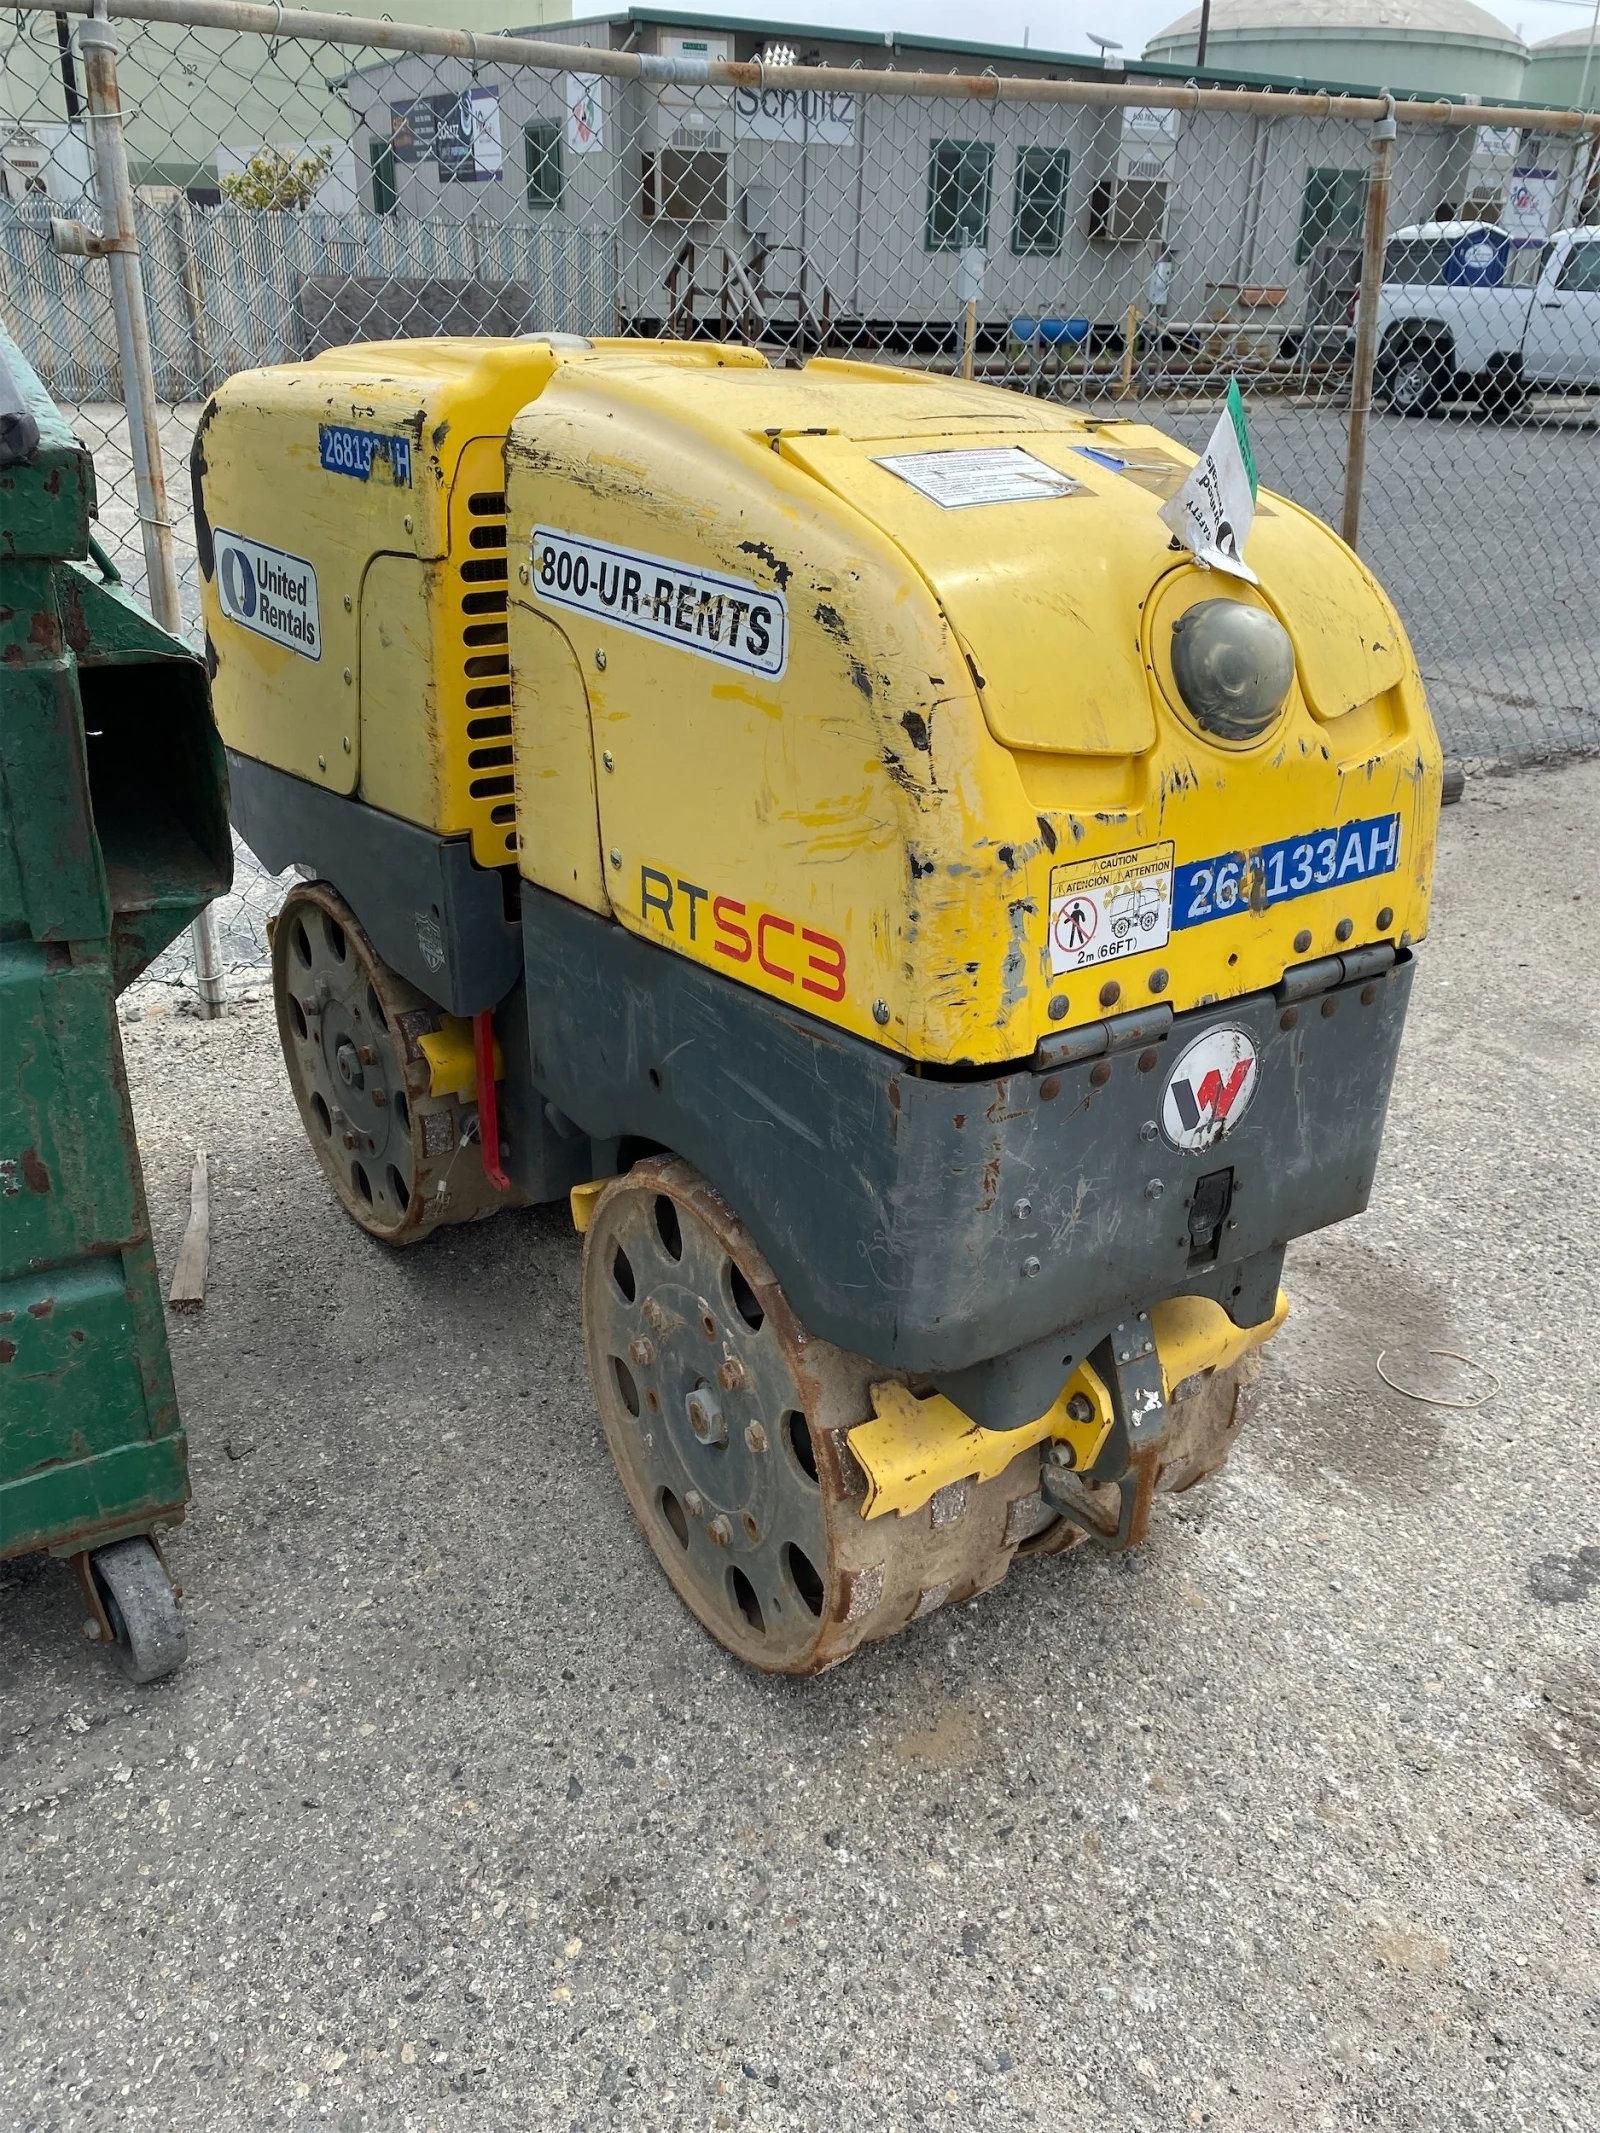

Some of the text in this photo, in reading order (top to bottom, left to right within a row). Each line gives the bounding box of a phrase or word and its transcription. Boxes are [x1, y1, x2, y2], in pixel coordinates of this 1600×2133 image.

[736, 86, 855, 123] Schultz
[1186, 500, 1212, 541] SAFETY
[256, 557, 307, 607] United
[541, 546, 772, 656] 800-UR-RENTS
[259, 592, 315, 645] Rentals
[1100, 853, 1138, 870] CAUTION
[1124, 860, 1170, 880] ATTENTION
